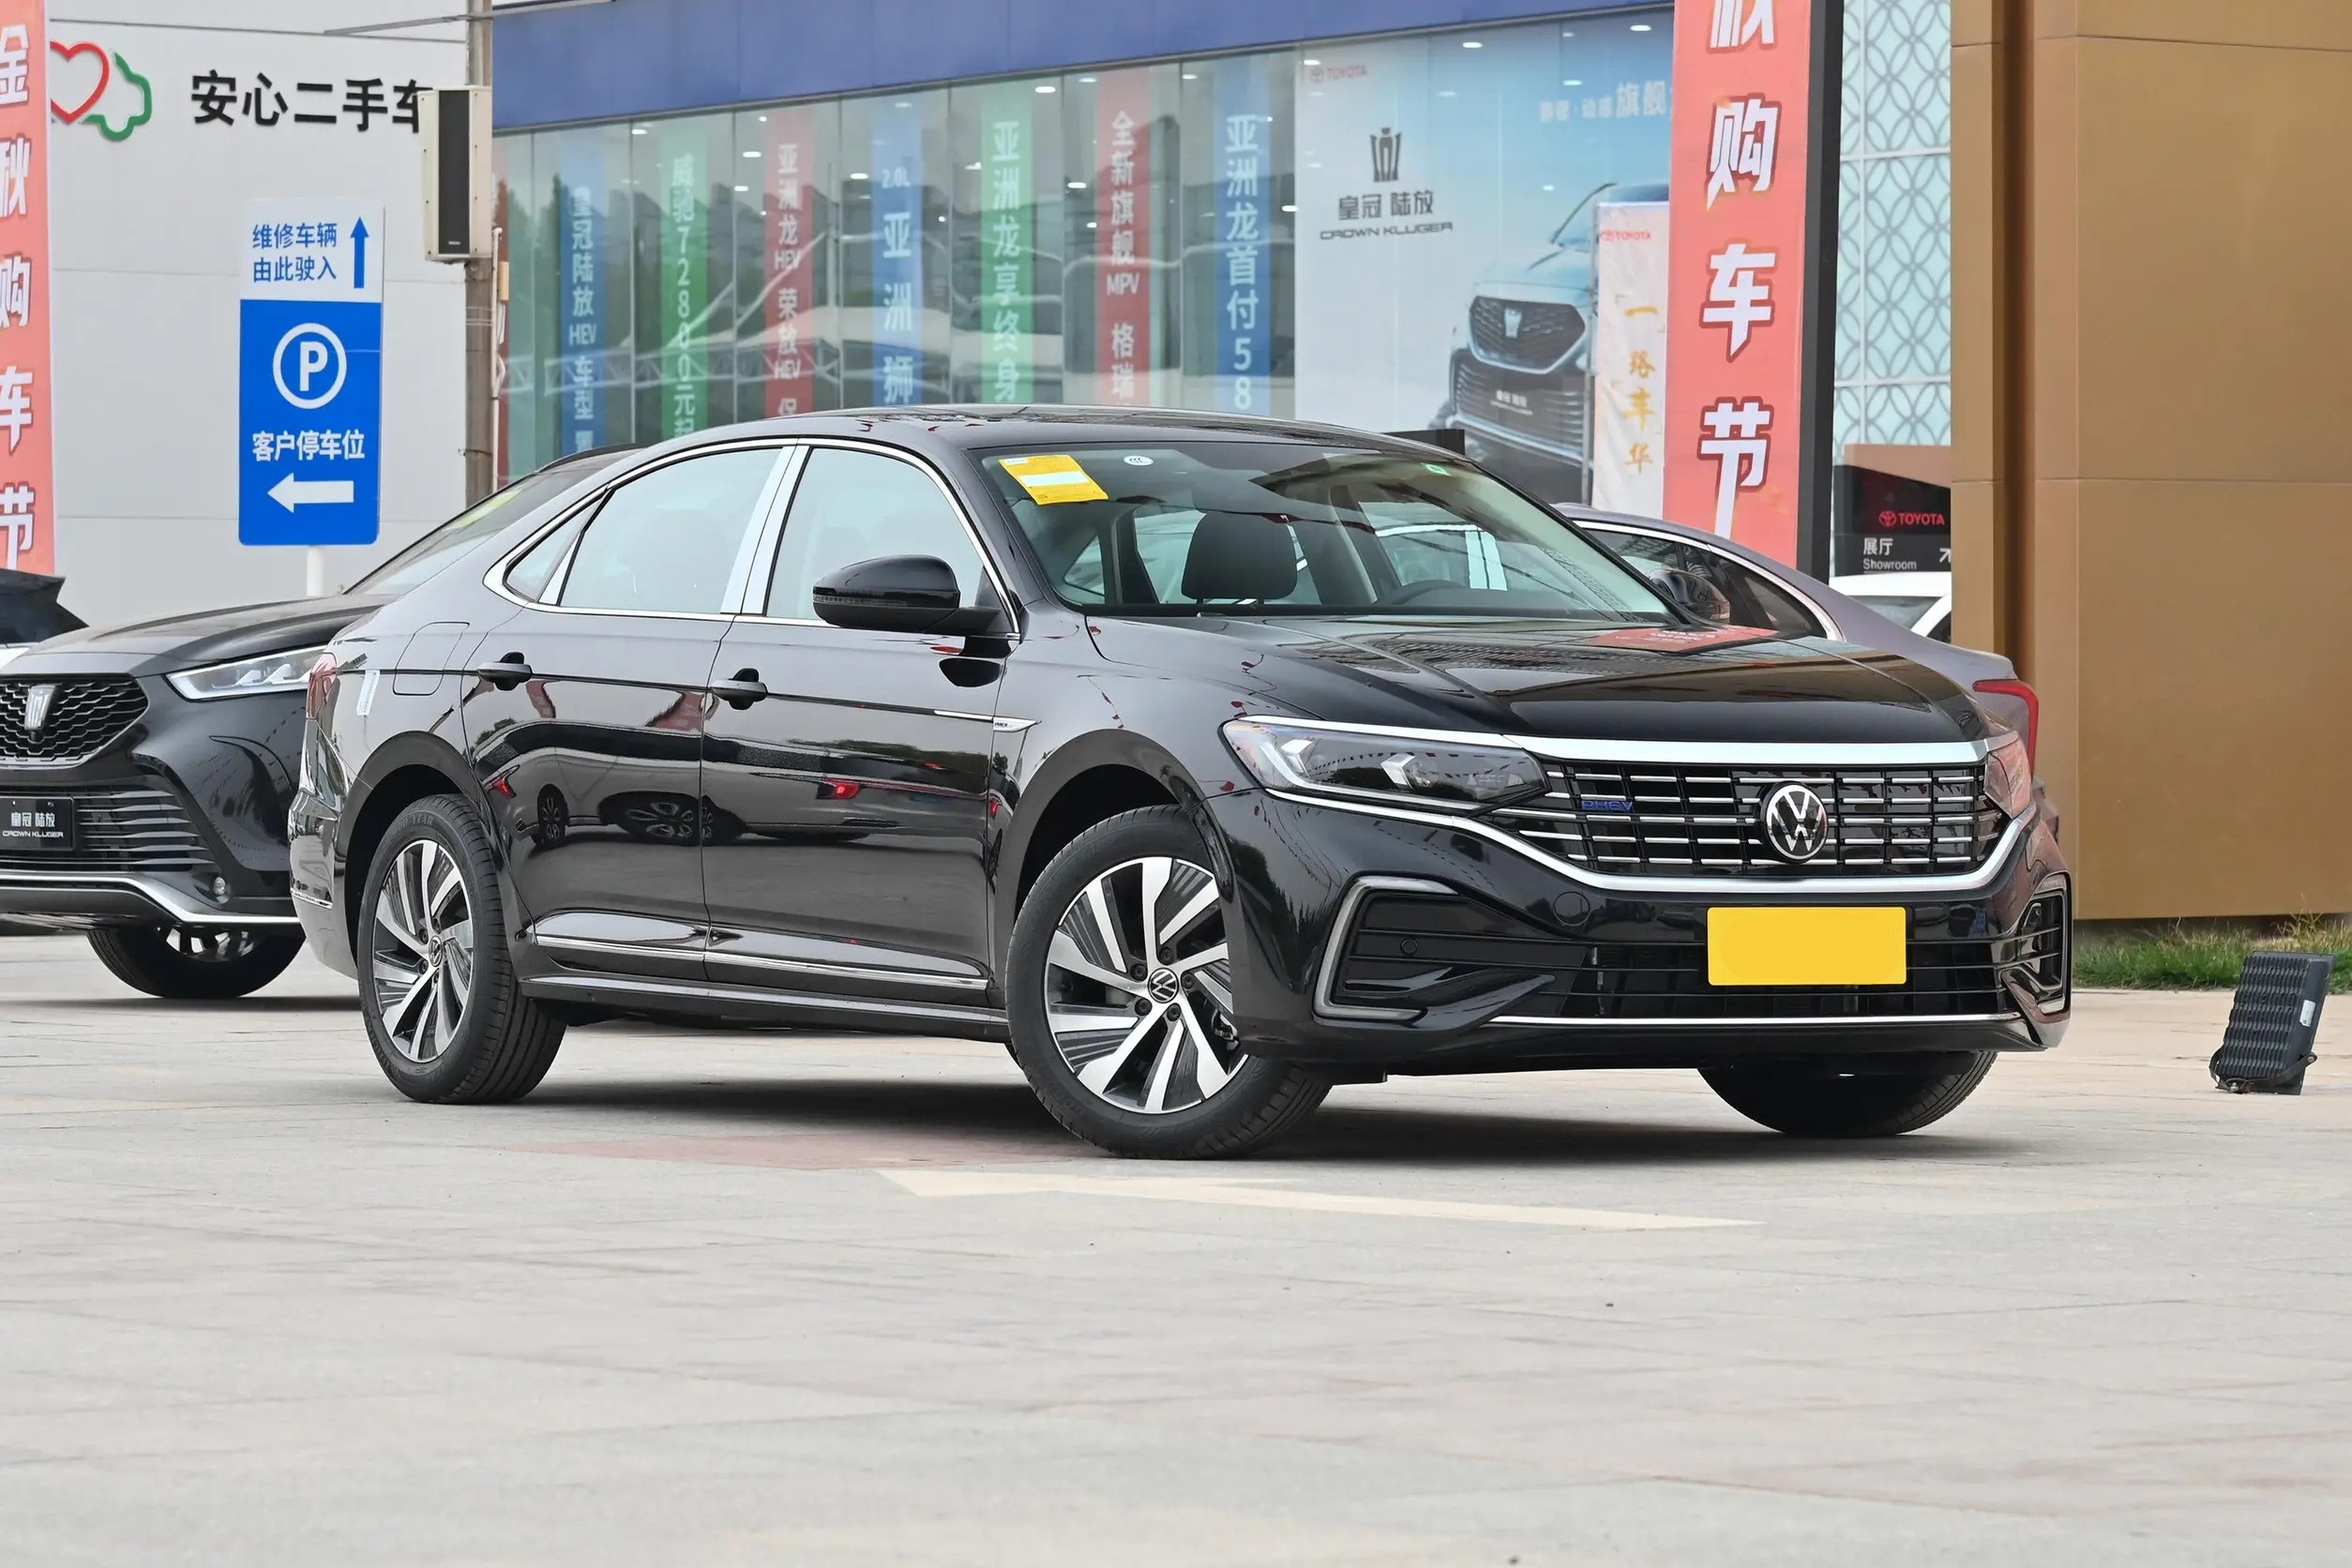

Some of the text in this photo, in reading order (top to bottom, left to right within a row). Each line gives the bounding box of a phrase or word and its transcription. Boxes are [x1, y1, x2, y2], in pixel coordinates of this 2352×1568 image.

[1338, 189, 1433, 220] 皇冠 陆放
[252, 222, 338, 249] 维修车辆
[1319, 221, 1453, 240] CROWN KLUGER
[252, 255, 338, 282] 由此驶入
[1225, 113, 1259, 411] 亚洲龙首付58
[882, 211, 913, 405] 亚洲狮
[299, 341, 328, 391] P
[251, 430, 366, 462] 客户停车位
[1897, 512, 1946, 525] TOYOTA
[1862, 537, 1894, 556] 展厅
[1862, 558, 1918, 570] Showroom
[11, 812, 55, 827] 皇冠 陆放
[1580, 800, 1634, 812] PHEV
